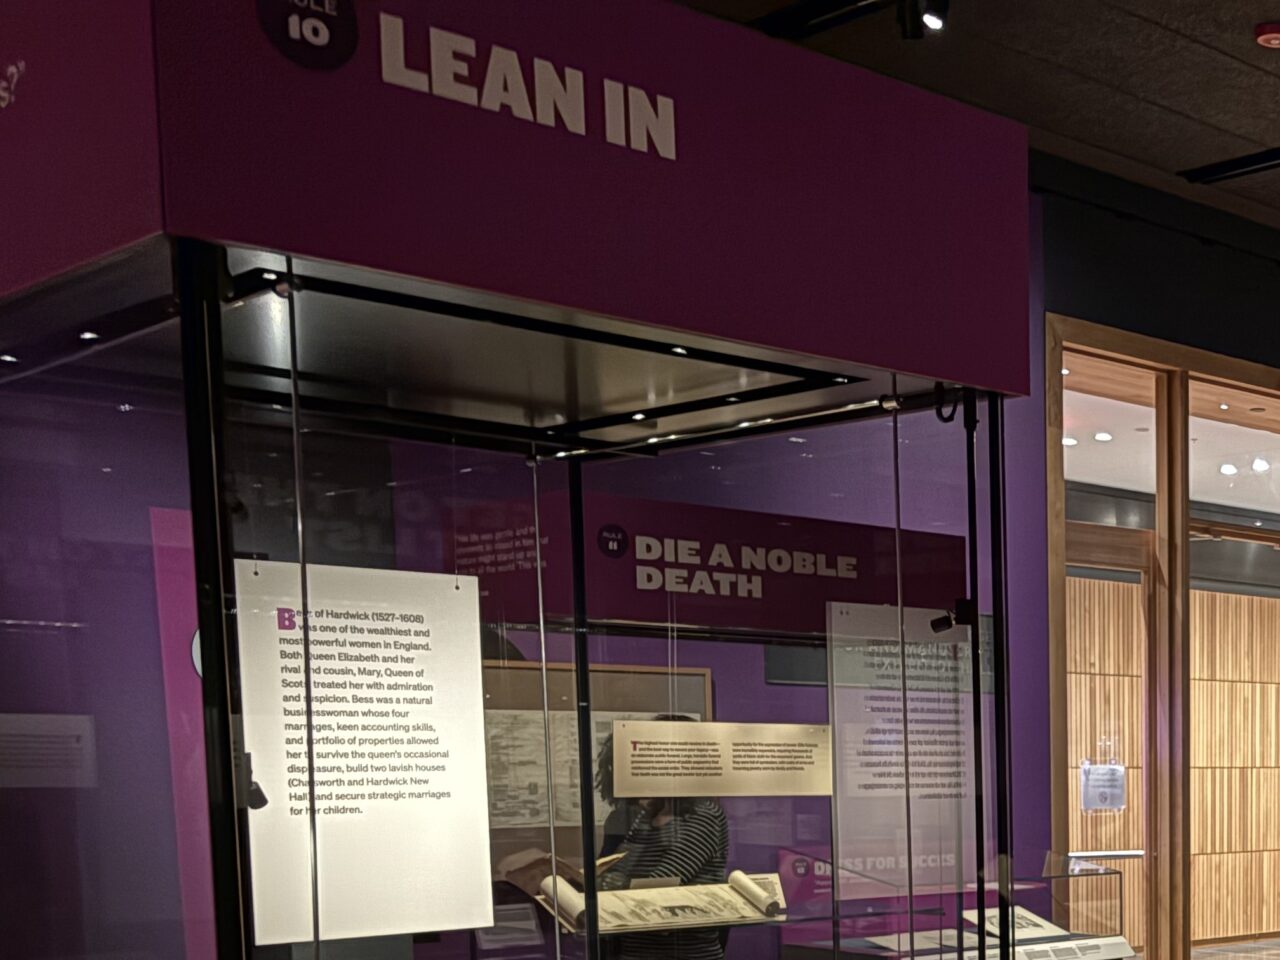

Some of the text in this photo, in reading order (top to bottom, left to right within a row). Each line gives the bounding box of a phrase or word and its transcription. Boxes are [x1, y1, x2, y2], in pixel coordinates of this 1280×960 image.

[288, 15, 331, 46] 10
[379, 12, 677, 160] LEAN IN
[635, 535, 858, 578] DIE A NOBLE
[636, 565, 762, 598] DEATH
[315, 610, 324, 618] of
[326, 610, 370, 620] Hardwick
[319, 625, 337, 633] one
[339, 624, 348, 633] of
[350, 624, 365, 634] the
[367, 625, 411, 636] wealthiest
[413, 628, 430, 637] and
[349, 641, 381, 649] women
[384, 640, 391, 649] in
[394, 641, 431, 651] England.
[280, 651, 302, 659] Both
[338, 653, 379, 663] Elizabeth
[382, 654, 398, 663] and
[400, 654, 414, 663] her
[281, 665, 300, 674] rival
[323, 666, 356, 676] cousin,
[358, 667, 383, 678] Mary,
[385, 668, 413, 678] Queen
[416, 669, 425, 677] of
[314, 681, 347, 690] treated
[349, 680, 363, 690] her
[366, 681, 384, 690] with
[387, 681, 433, 691] admiration
[283, 694, 300, 702] and
[352, 695, 374, 704] Bess
[376, 696, 393, 704] was
[403, 696, 432, 704] natural
[361, 709, 390, 718] whose
[392, 709, 410, 718] four
[337, 723, 359, 731] keen
[361, 723, 410, 733] accounting
[412, 723, 436, 732] skills,
[307, 737, 346, 746] ortfolio
[348, 736, 356, 744] of
[359, 737, 404, 746] properties
[407, 737, 439, 745] allowed
[286, 750, 302, 759] her
[316, 751, 349, 759] survive
[351, 750, 366, 759] the
[368, 750, 401, 760] queen's
[403, 750, 449, 759] occasional
[346, 764, 368, 772] build
[389, 764, 413, 772] lavish
[415, 763, 446, 772] houses
[347, 778, 364, 786] and
[367, 777, 408, 786] Hardwick
[410, 777, 429, 785] New
[316, 792, 332, 800] and
[335, 792, 366, 800] secure
[368, 791, 406, 801] strategic
[408, 790, 451, 799] marriages
[290, 806, 363, 815] for hr children.
[814, 857, 863, 876] DRSS
[866, 856, 897, 870] FOR
